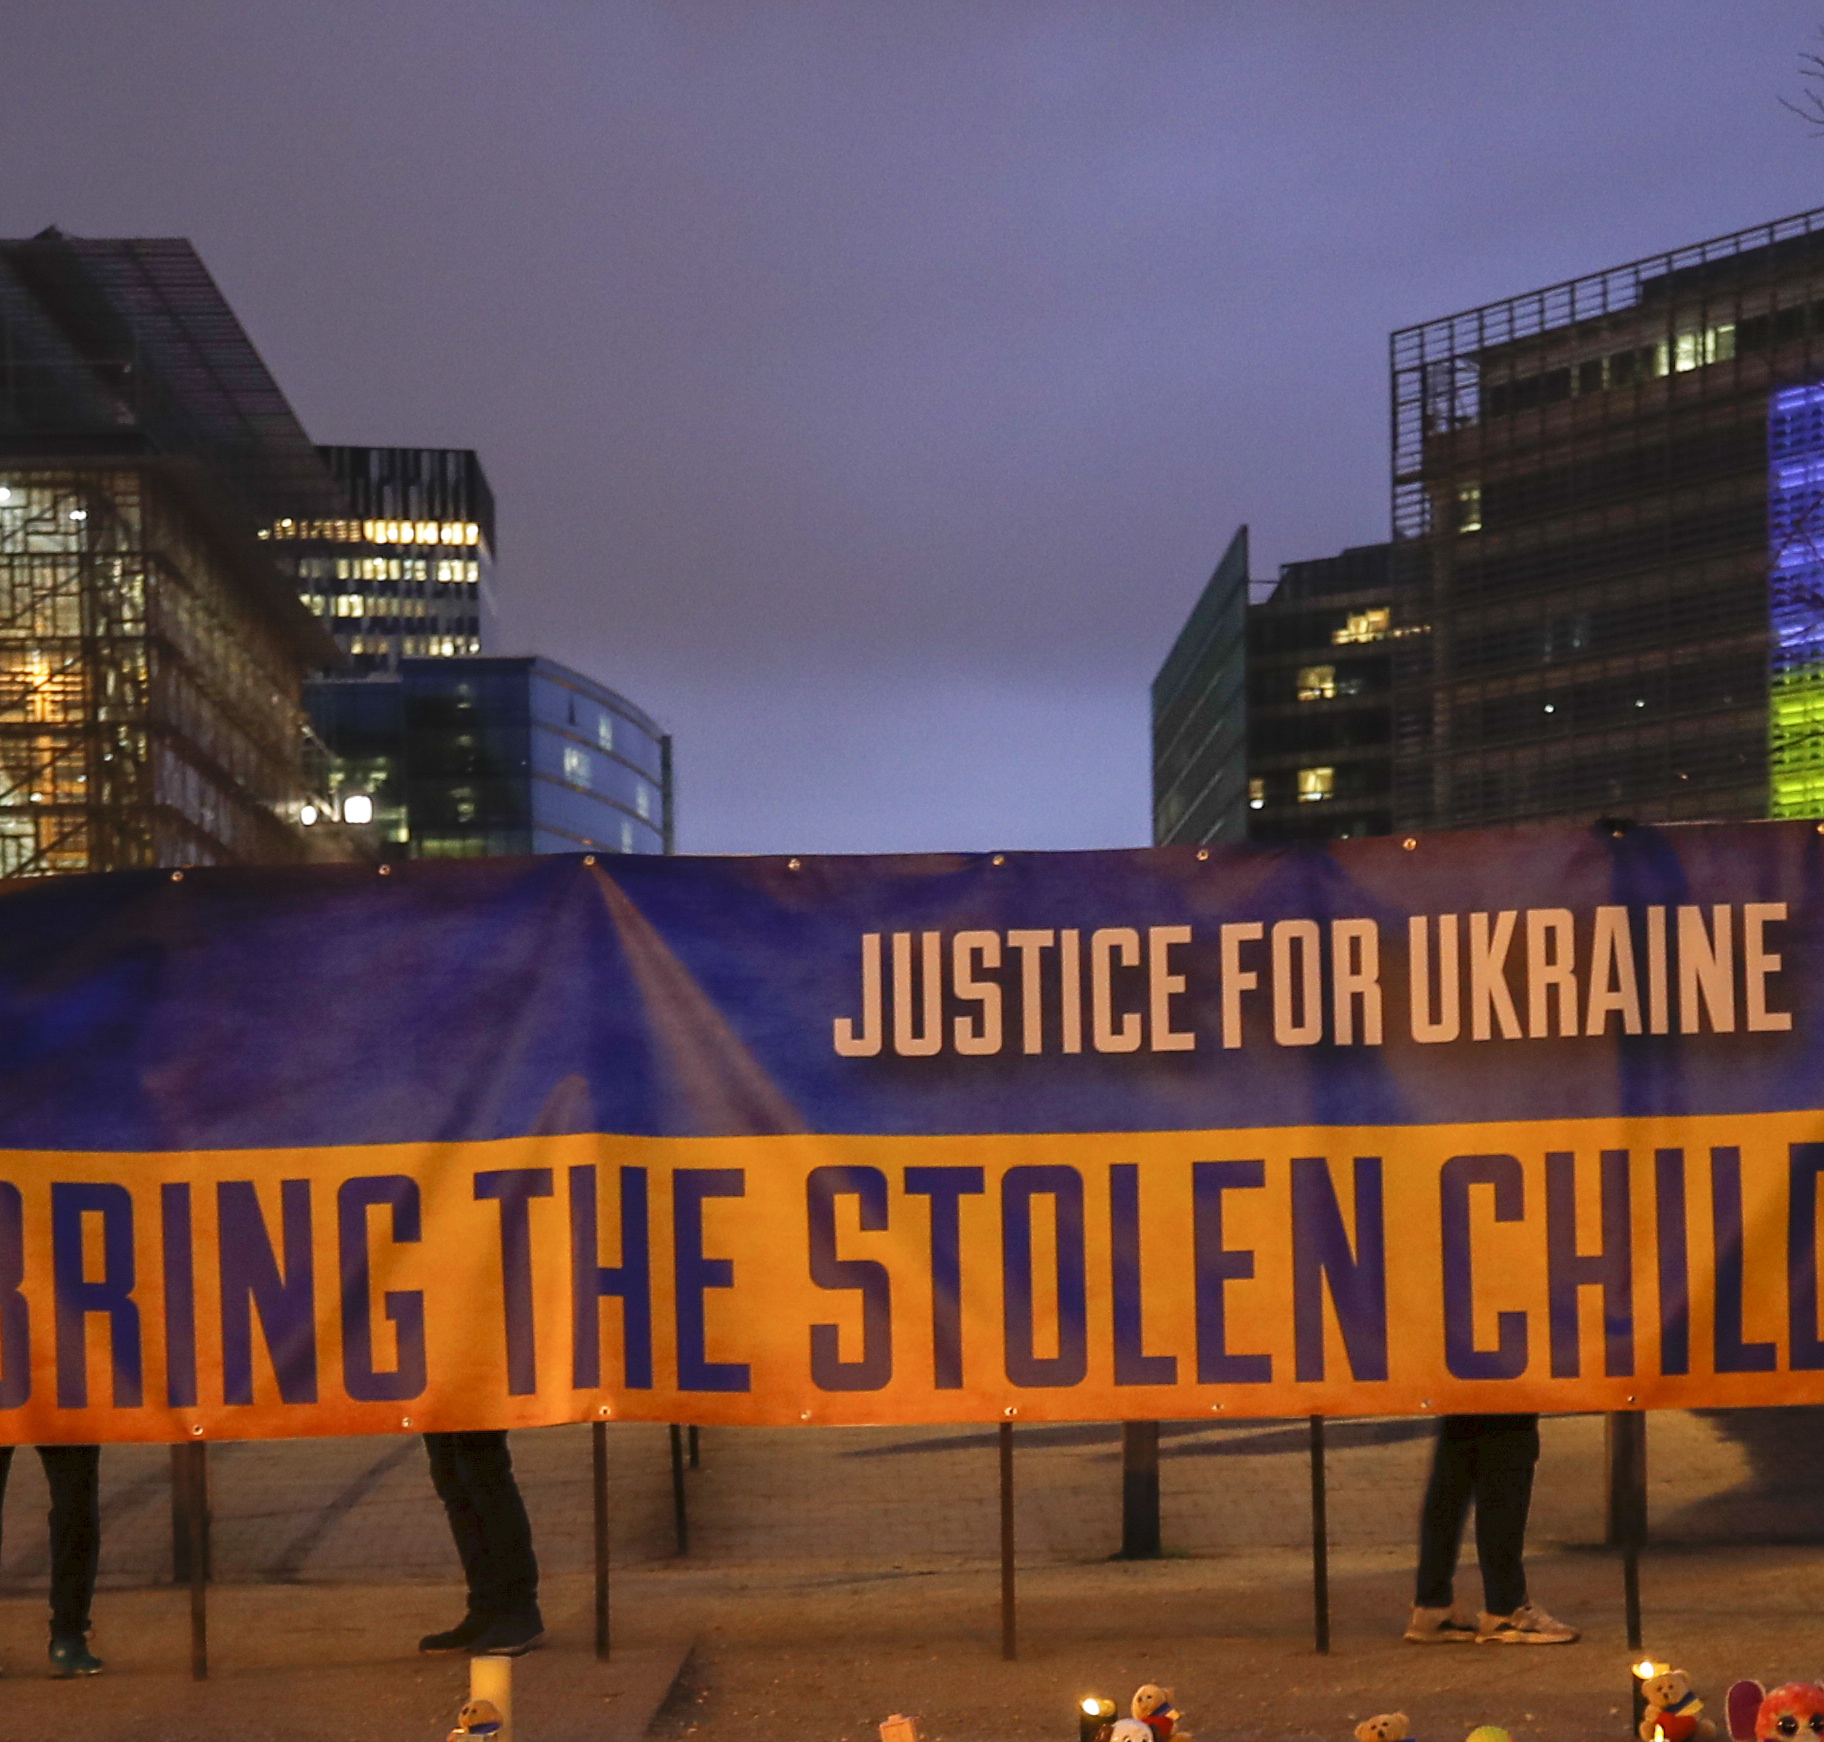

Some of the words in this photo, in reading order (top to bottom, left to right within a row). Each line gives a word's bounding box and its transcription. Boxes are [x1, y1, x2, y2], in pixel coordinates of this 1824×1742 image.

[832, 925, 1195, 1057] JUSTICE
[1219, 917, 1383, 1050] FOR
[1408, 901, 1793, 1046] UKRAINE
[473, 1165, 752, 1397] THE
[806, 1155, 1389, 1392] STOLEN
